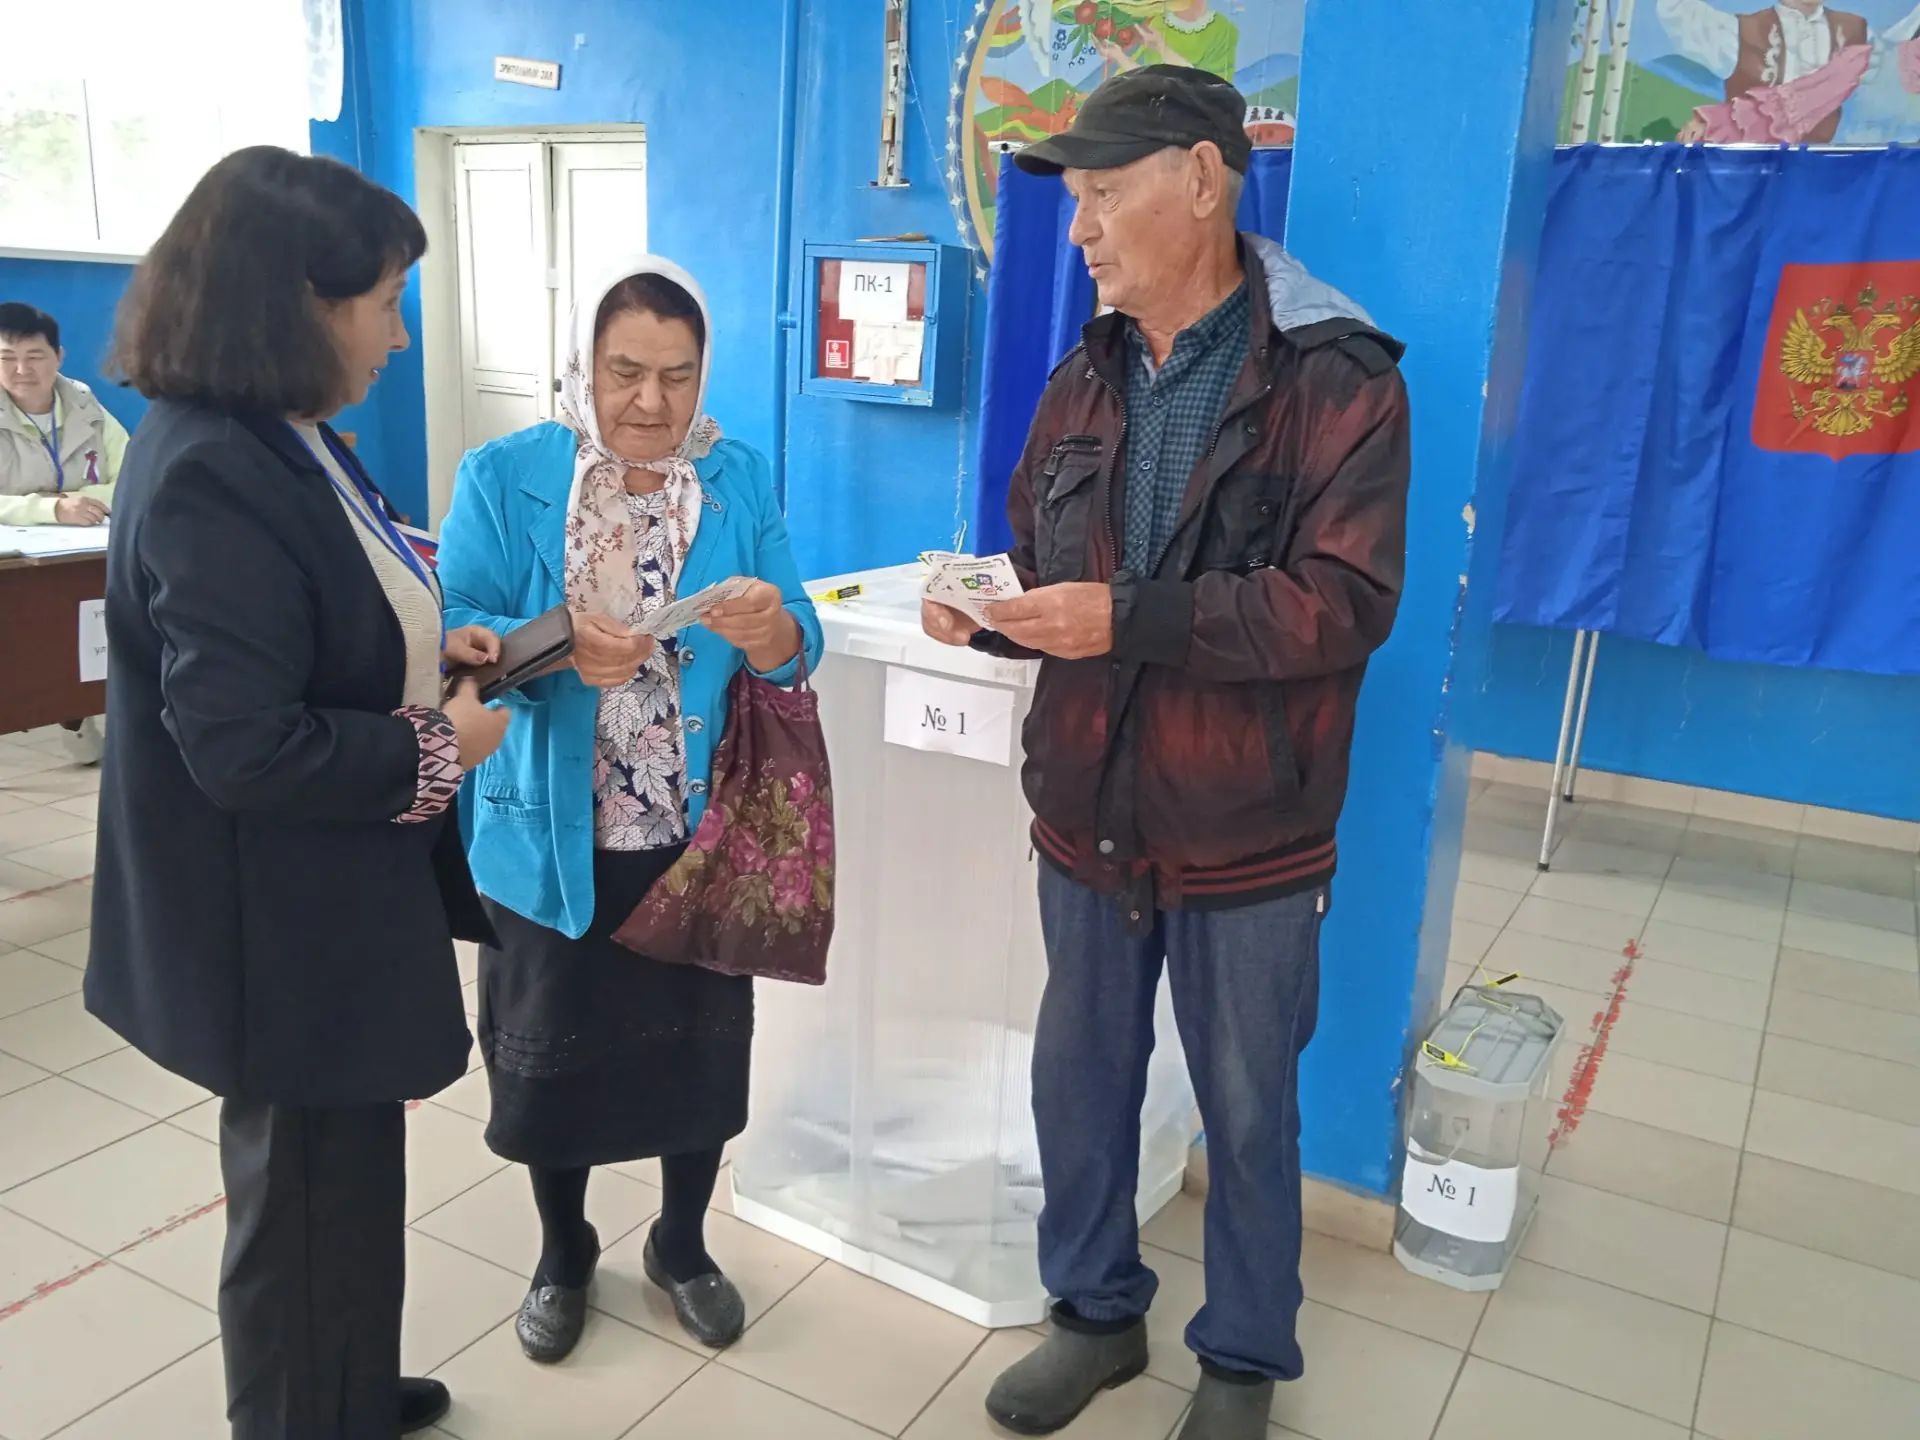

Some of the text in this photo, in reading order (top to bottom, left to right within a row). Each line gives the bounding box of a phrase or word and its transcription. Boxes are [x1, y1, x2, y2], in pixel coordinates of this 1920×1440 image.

[854, 274, 893, 293] ПК-1
[921, 704, 967, 735] № 1
[1426, 1173, 1476, 1207] № 1
